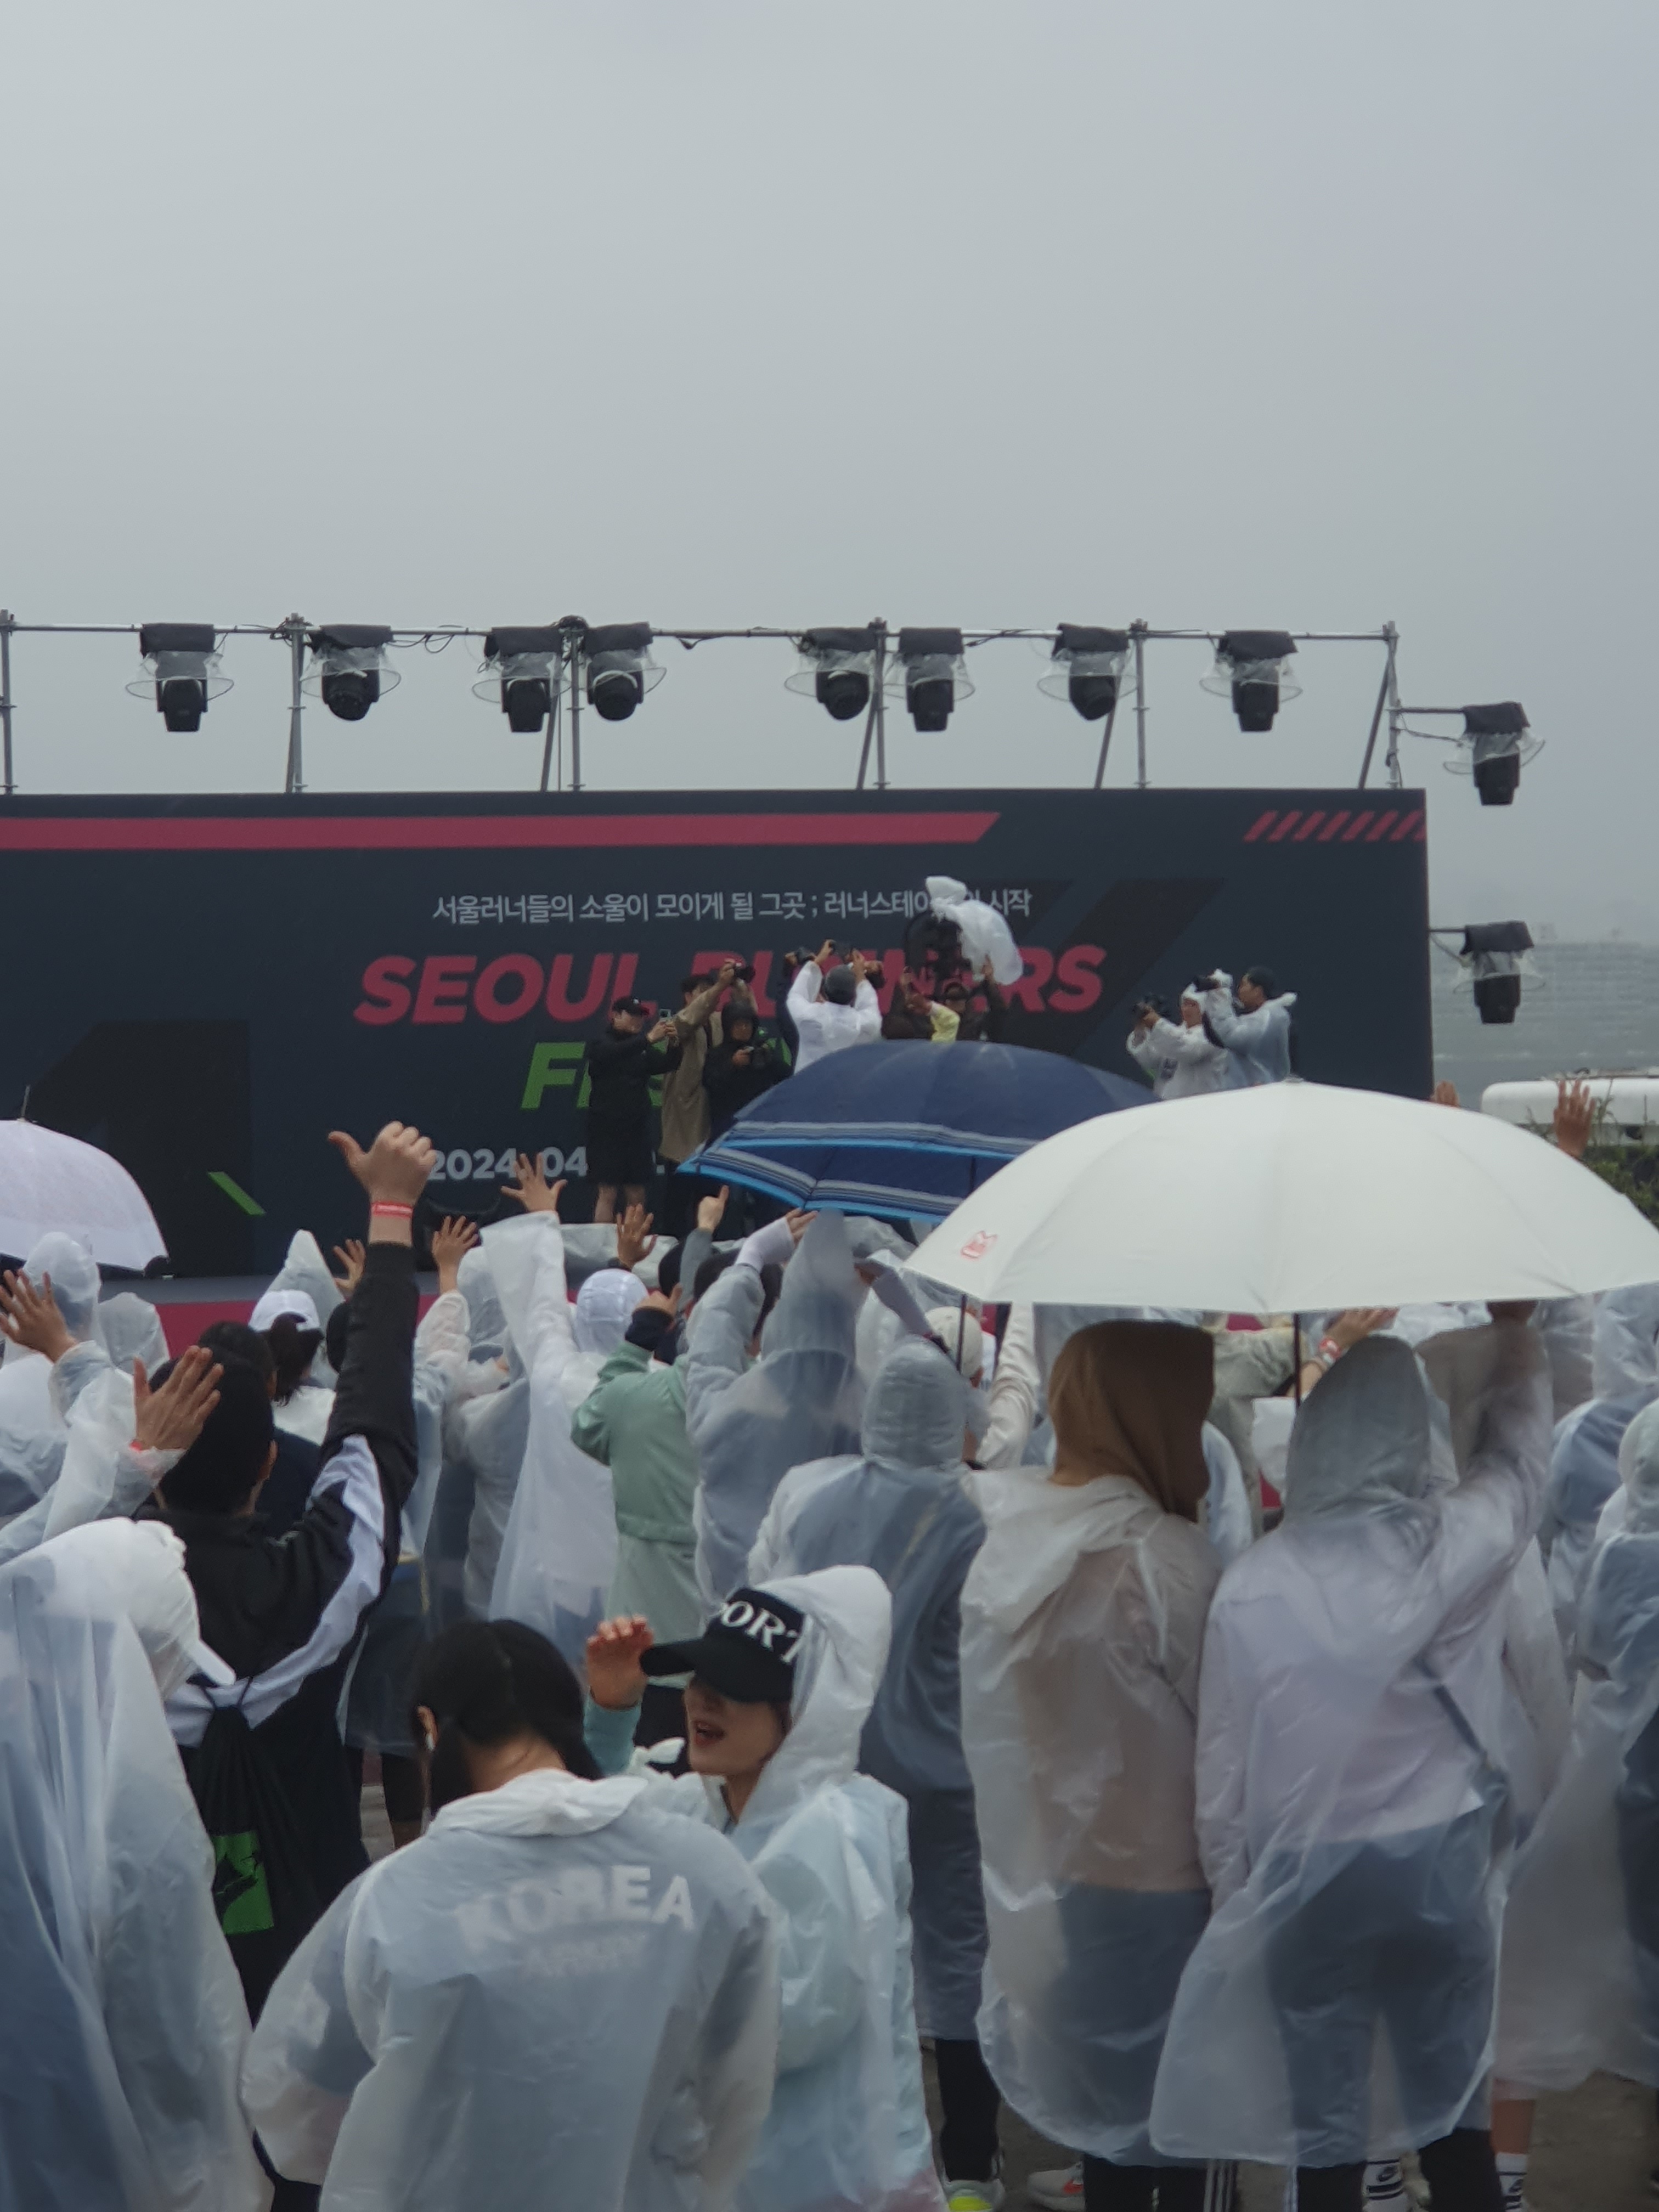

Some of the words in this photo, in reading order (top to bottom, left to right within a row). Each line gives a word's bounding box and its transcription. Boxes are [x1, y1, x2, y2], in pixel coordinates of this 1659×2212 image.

[433, 894, 574, 924] 서울러너들의
[579, 893, 648, 922] 소울이
[655, 891, 724, 921] 모이게
[730, 891, 754, 921] 될
[759, 891, 806, 919] 그곳
[989, 888, 1033, 917] 시작
[354, 953, 657, 1026] SEOUL
[454, 1865, 693, 1955] KOREA
